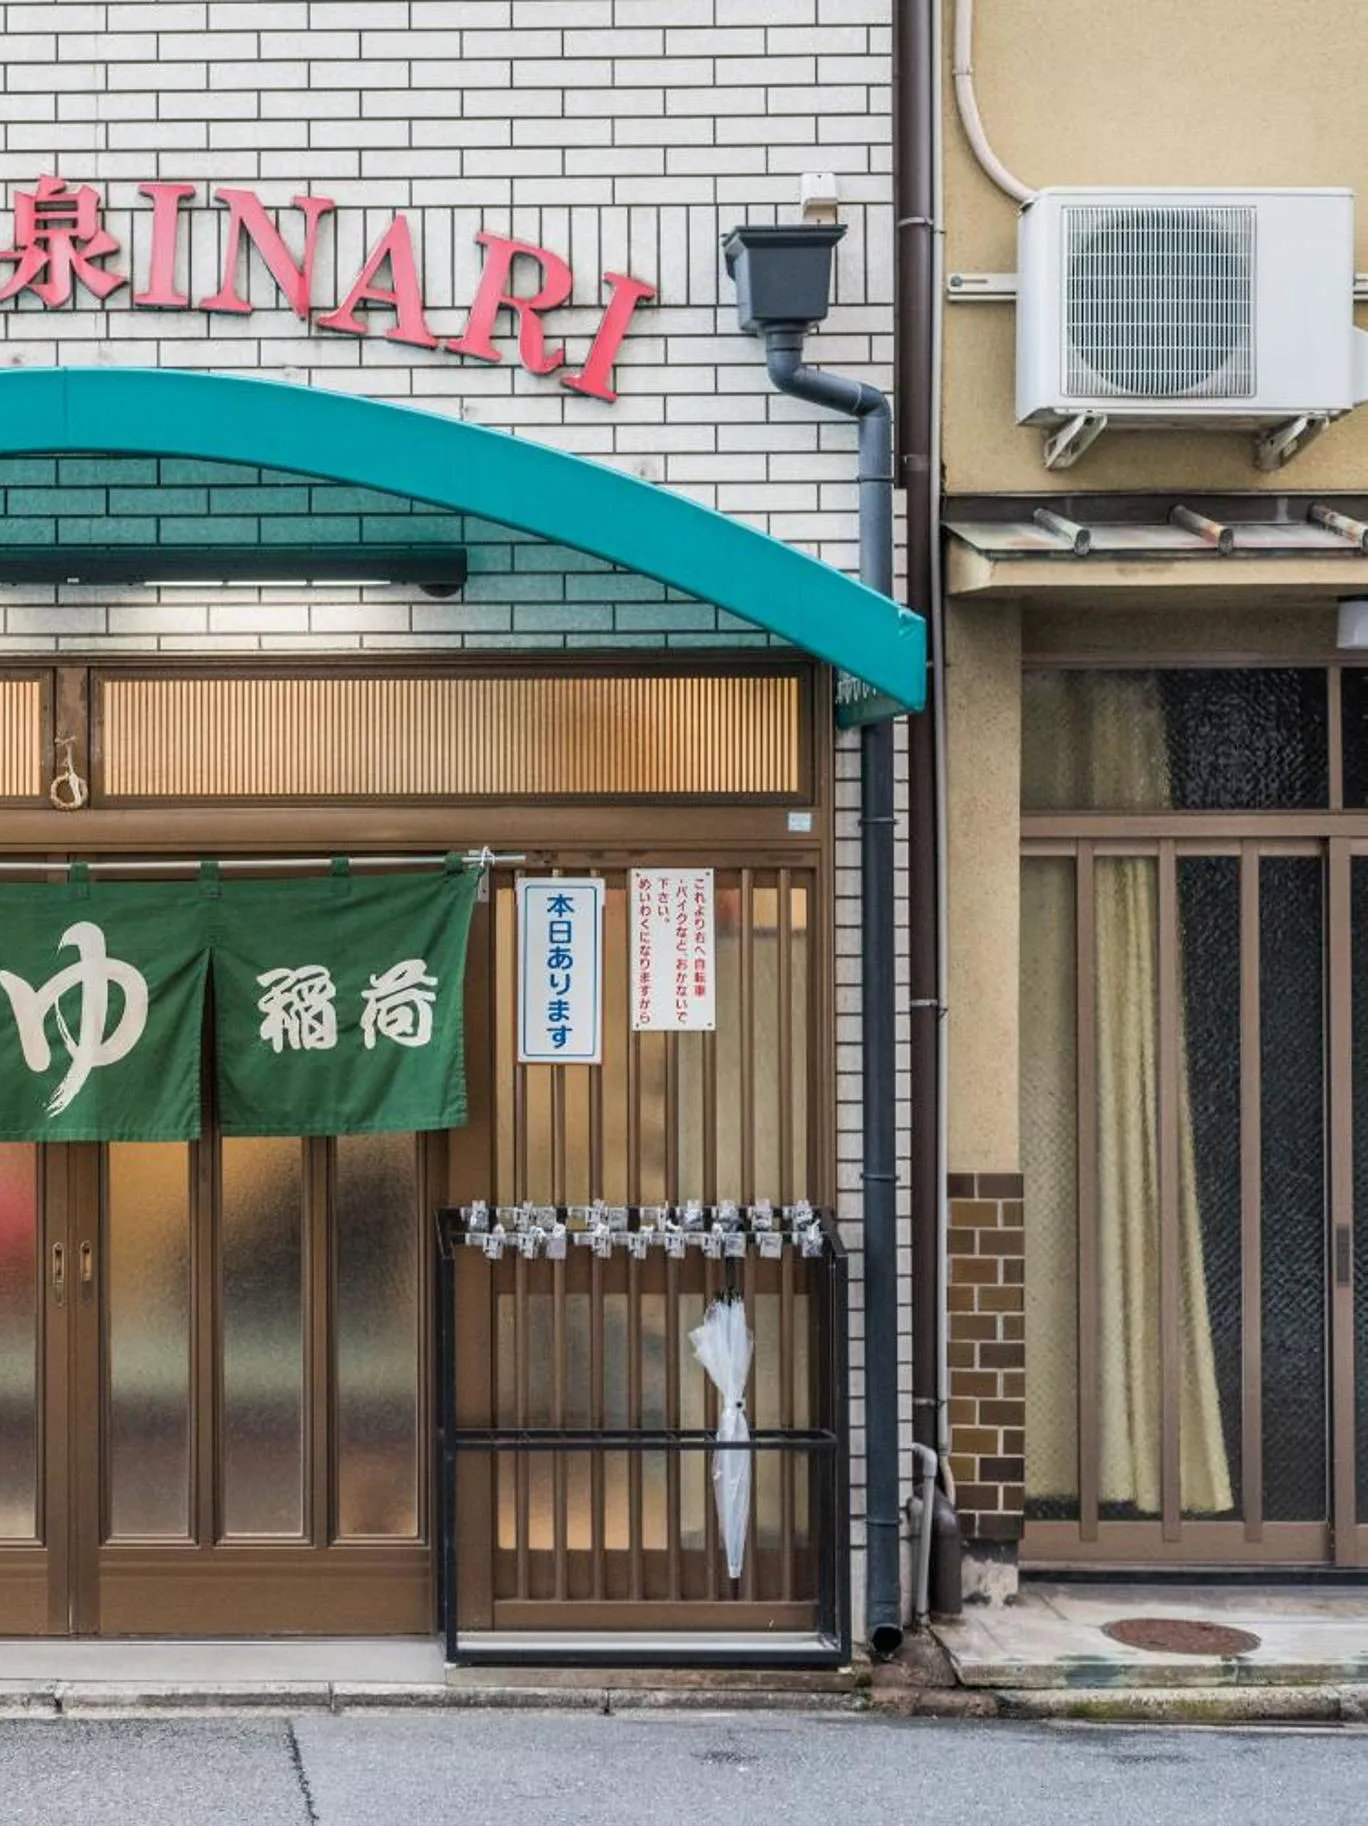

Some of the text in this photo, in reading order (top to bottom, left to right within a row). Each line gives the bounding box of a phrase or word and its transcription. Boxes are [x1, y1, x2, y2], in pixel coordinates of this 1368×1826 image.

[255, 958, 439, 1054] 稲荷
[546, 893, 575, 1049] 本日あります
